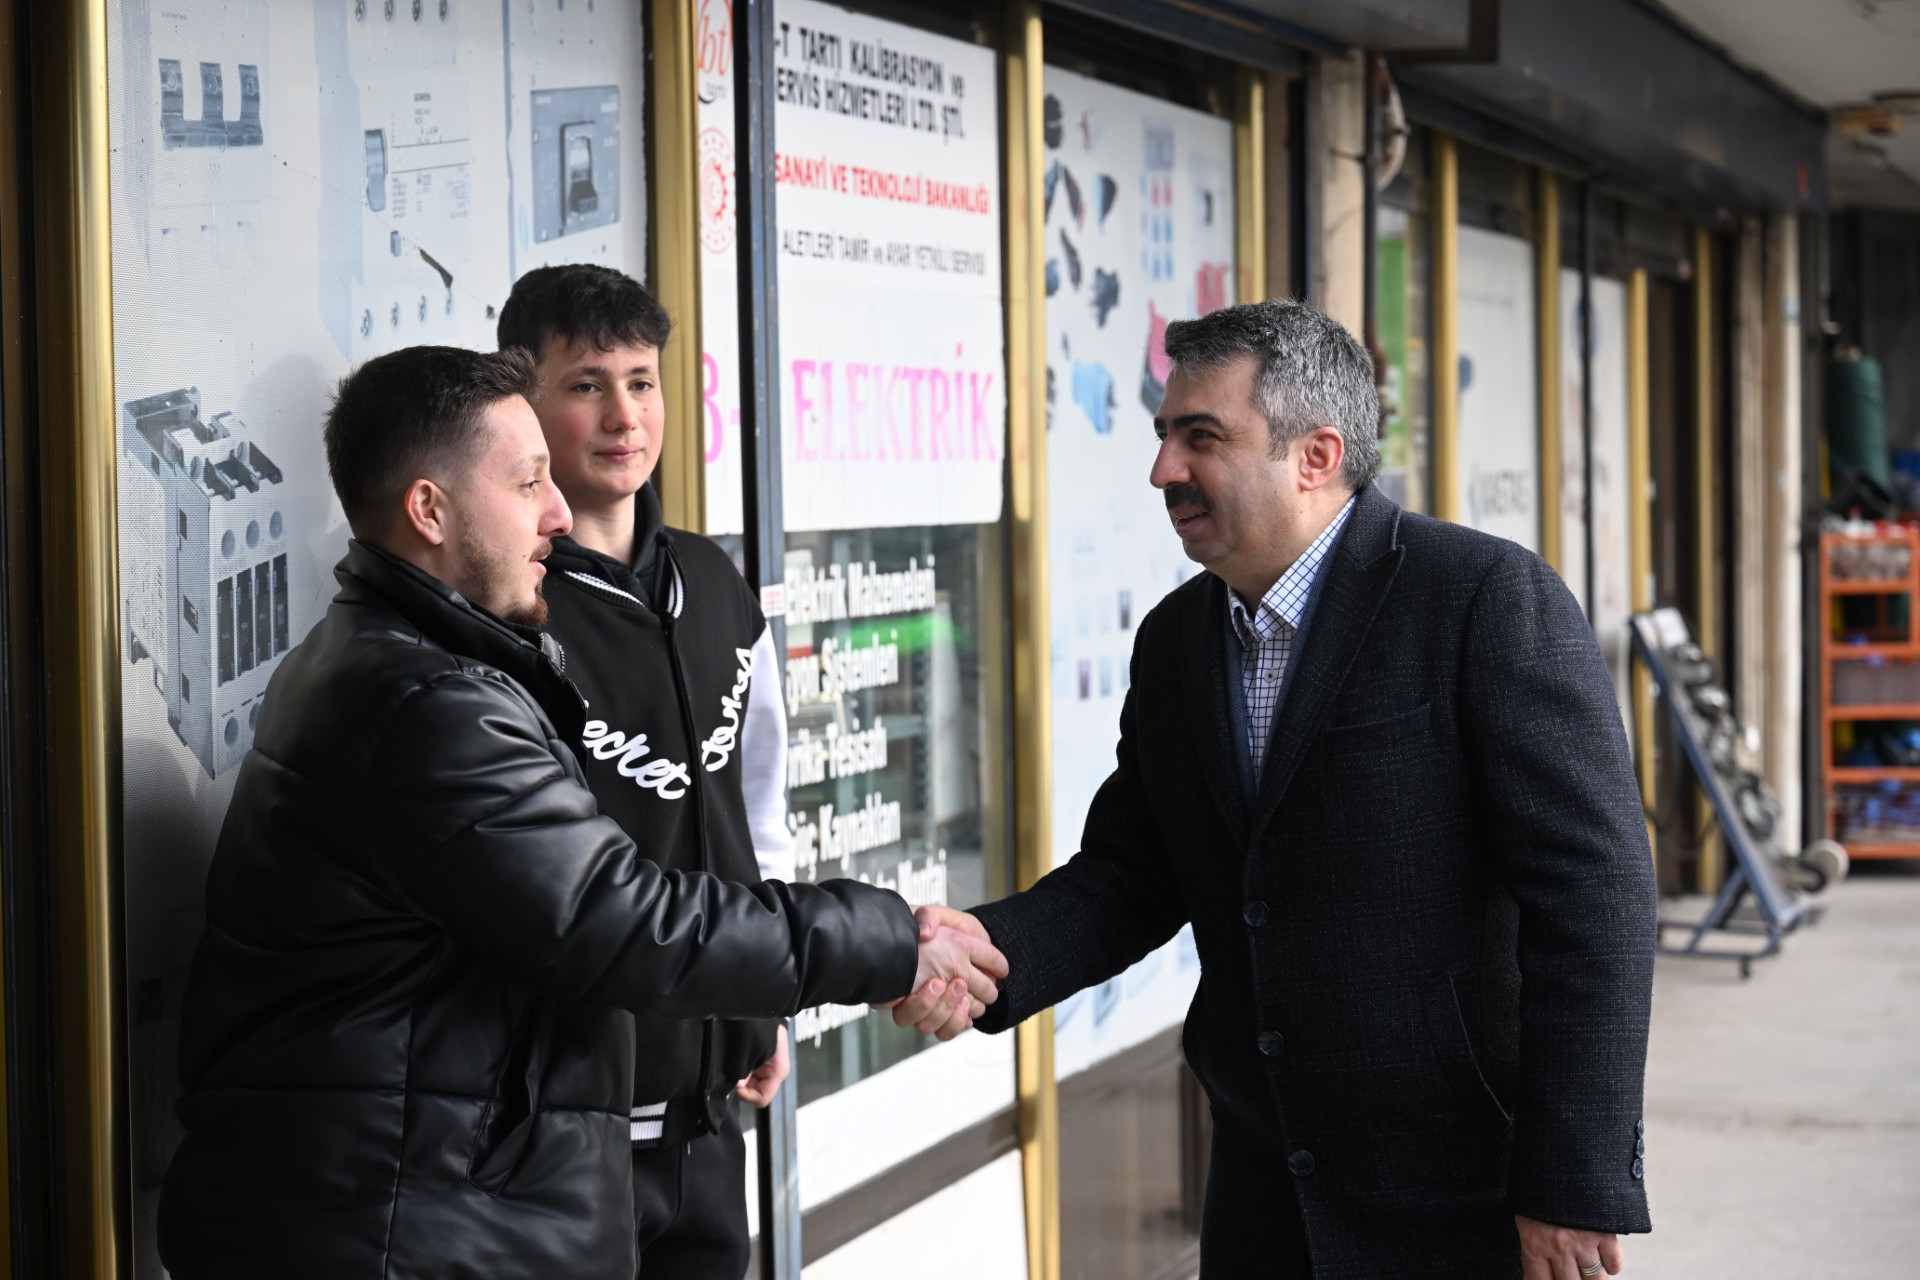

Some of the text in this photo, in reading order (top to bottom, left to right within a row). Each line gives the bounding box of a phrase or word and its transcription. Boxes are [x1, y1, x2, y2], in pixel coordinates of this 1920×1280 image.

[799, 27, 842, 71] TARTI
[850, 38, 945, 94] KALİBRASYON
[825, 71, 909, 128] HİZMETLERİ
[911, 97, 939, 133] LTD.
[775, 153, 991, 215] SANAYİ VE TEKNOLOJİ BAKANLIĞI
[783, 229, 835, 260] ALETLERİ
[838, 231, 869, 262] TAMİR
[887, 241, 911, 268] AYAR
[792, 342, 997, 463] ELEKTRİK
[785, 563, 848, 627] Elektrik
[848, 554, 936, 619] Malzemeleri
[822, 628, 899, 696] Sistemleri
[582, 703, 691, 800] ecret
[826, 715, 888, 779] Tesisatı
[819, 791, 901, 871] Kaynakları
